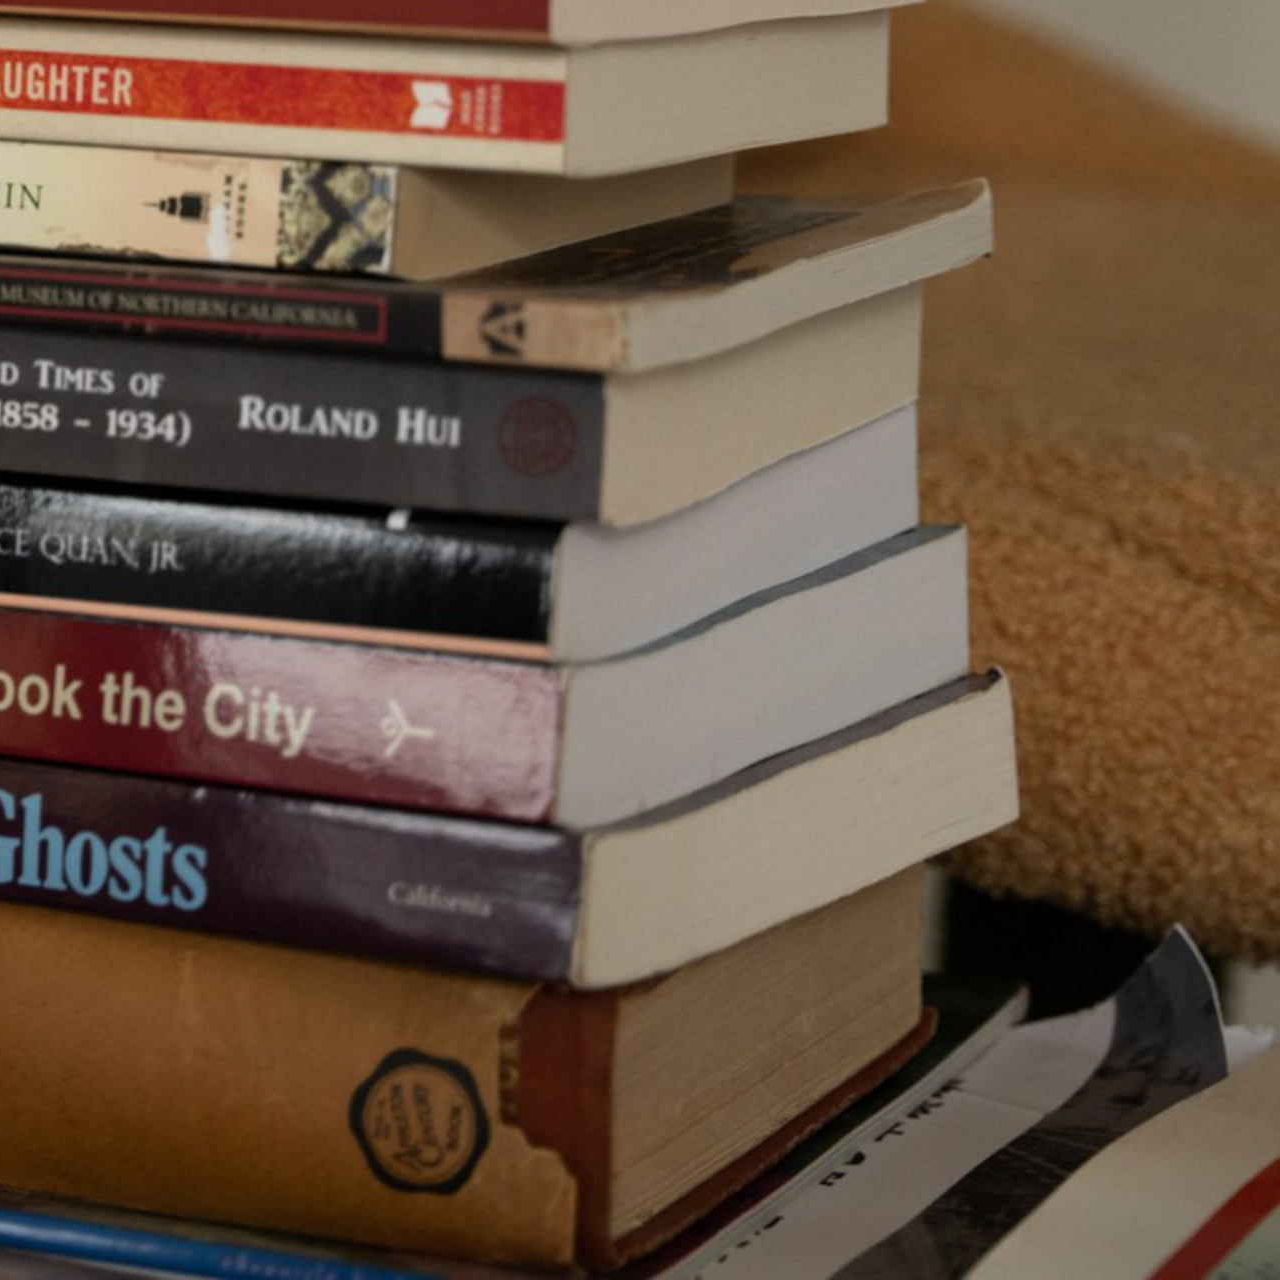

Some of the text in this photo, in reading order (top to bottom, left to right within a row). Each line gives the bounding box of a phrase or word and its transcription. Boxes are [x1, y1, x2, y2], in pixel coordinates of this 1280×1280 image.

[0, 281, 78, 308] MUSEUM
[82, 288, 113, 310] OF
[116, 290, 227, 320] NORTHERN
[231, 298, 358, 328] CALIFORNIA
[105, 410, 193, 447] 1934)
[237, 394, 379, 441] ROLAND
[100, 671, 187, 732] the
[203, 682, 316, 759] City
[385, 880, 495, 920] California
